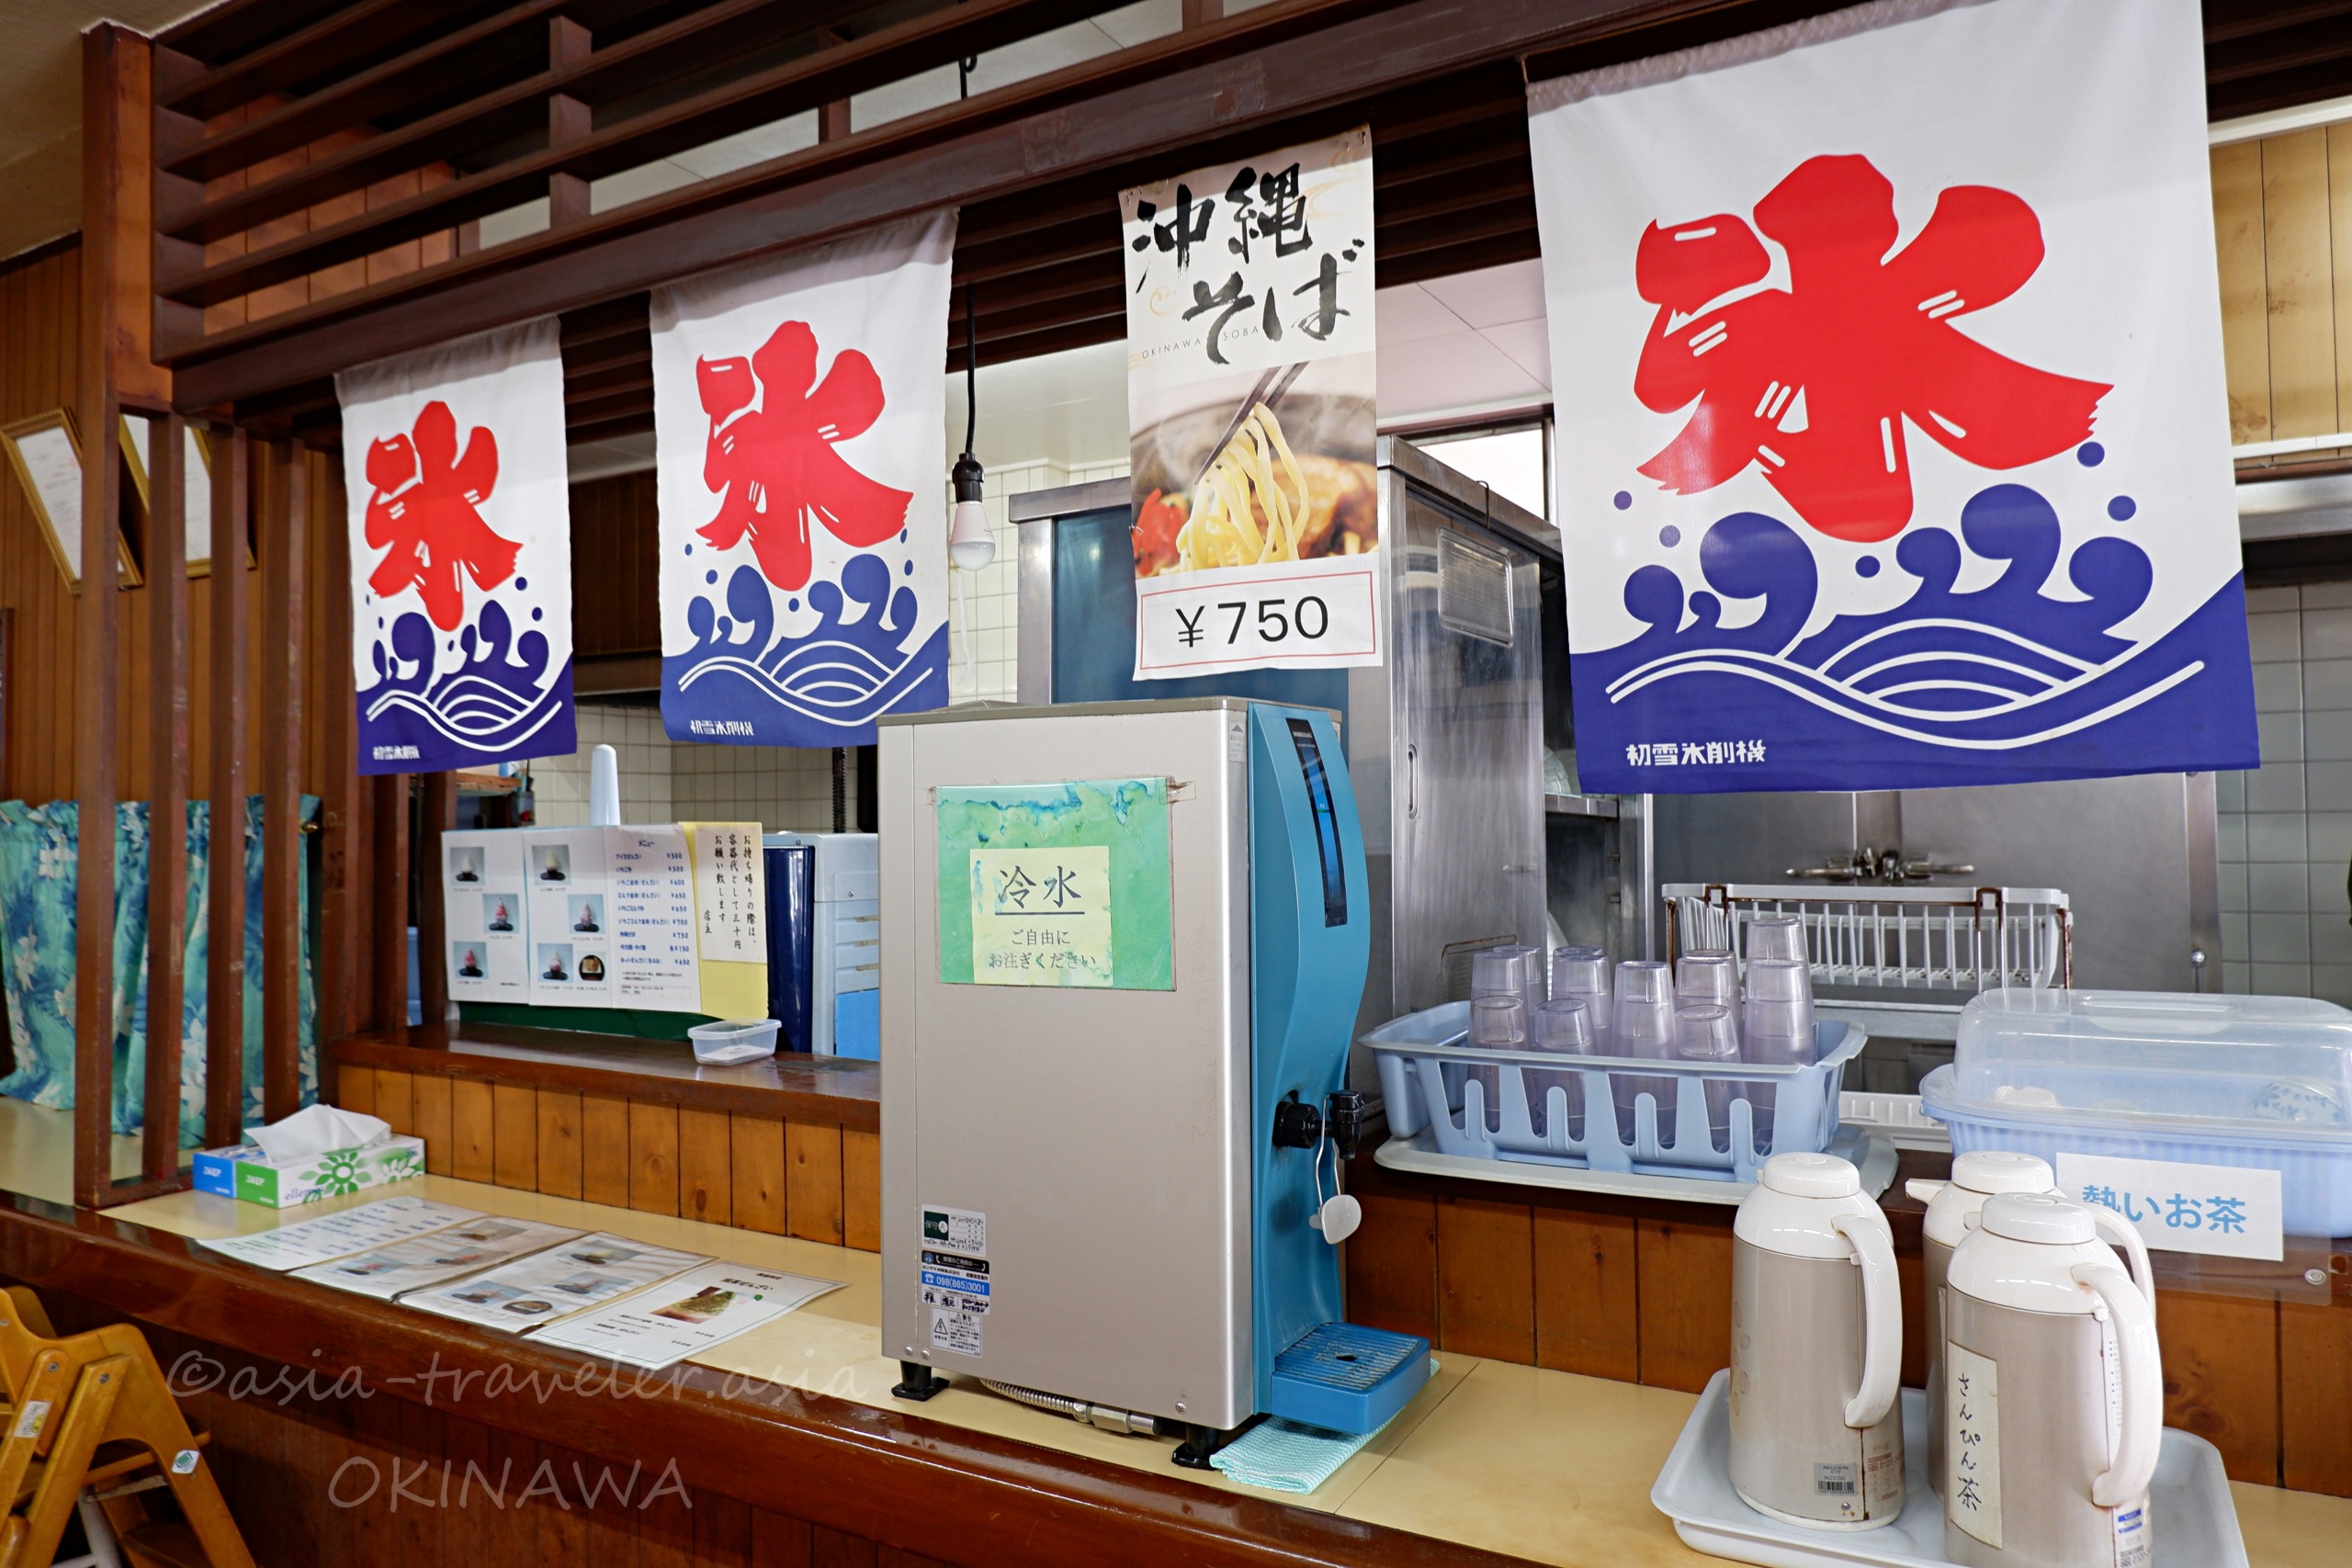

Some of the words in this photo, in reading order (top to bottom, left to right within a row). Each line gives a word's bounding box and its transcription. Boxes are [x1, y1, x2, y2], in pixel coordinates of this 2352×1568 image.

[1131, 162, 1314, 294] 沖縄
[1141, 336, 1202, 360] OKINAWA
[1222, 326, 1260, 342] SOBA
[1182, 238, 1365, 366] そば
[1633, 152, 2115, 544] 氷
[695, 319, 914, 592] 氷
[364, 400, 525, 633] 氷
[1624, 739, 1768, 768] 初雪氷削機
[714, 834, 727, 923] お願い致します
[998, 865, 1082, 909] 冷水
[989, 951, 1097, 970] お注ぎください
[1012, 929, 1071, 946] ご自由に
[936, 1276, 985, 1293] 098(865)3001
[1956, 1372, 1983, 1512] さんぴん茶
